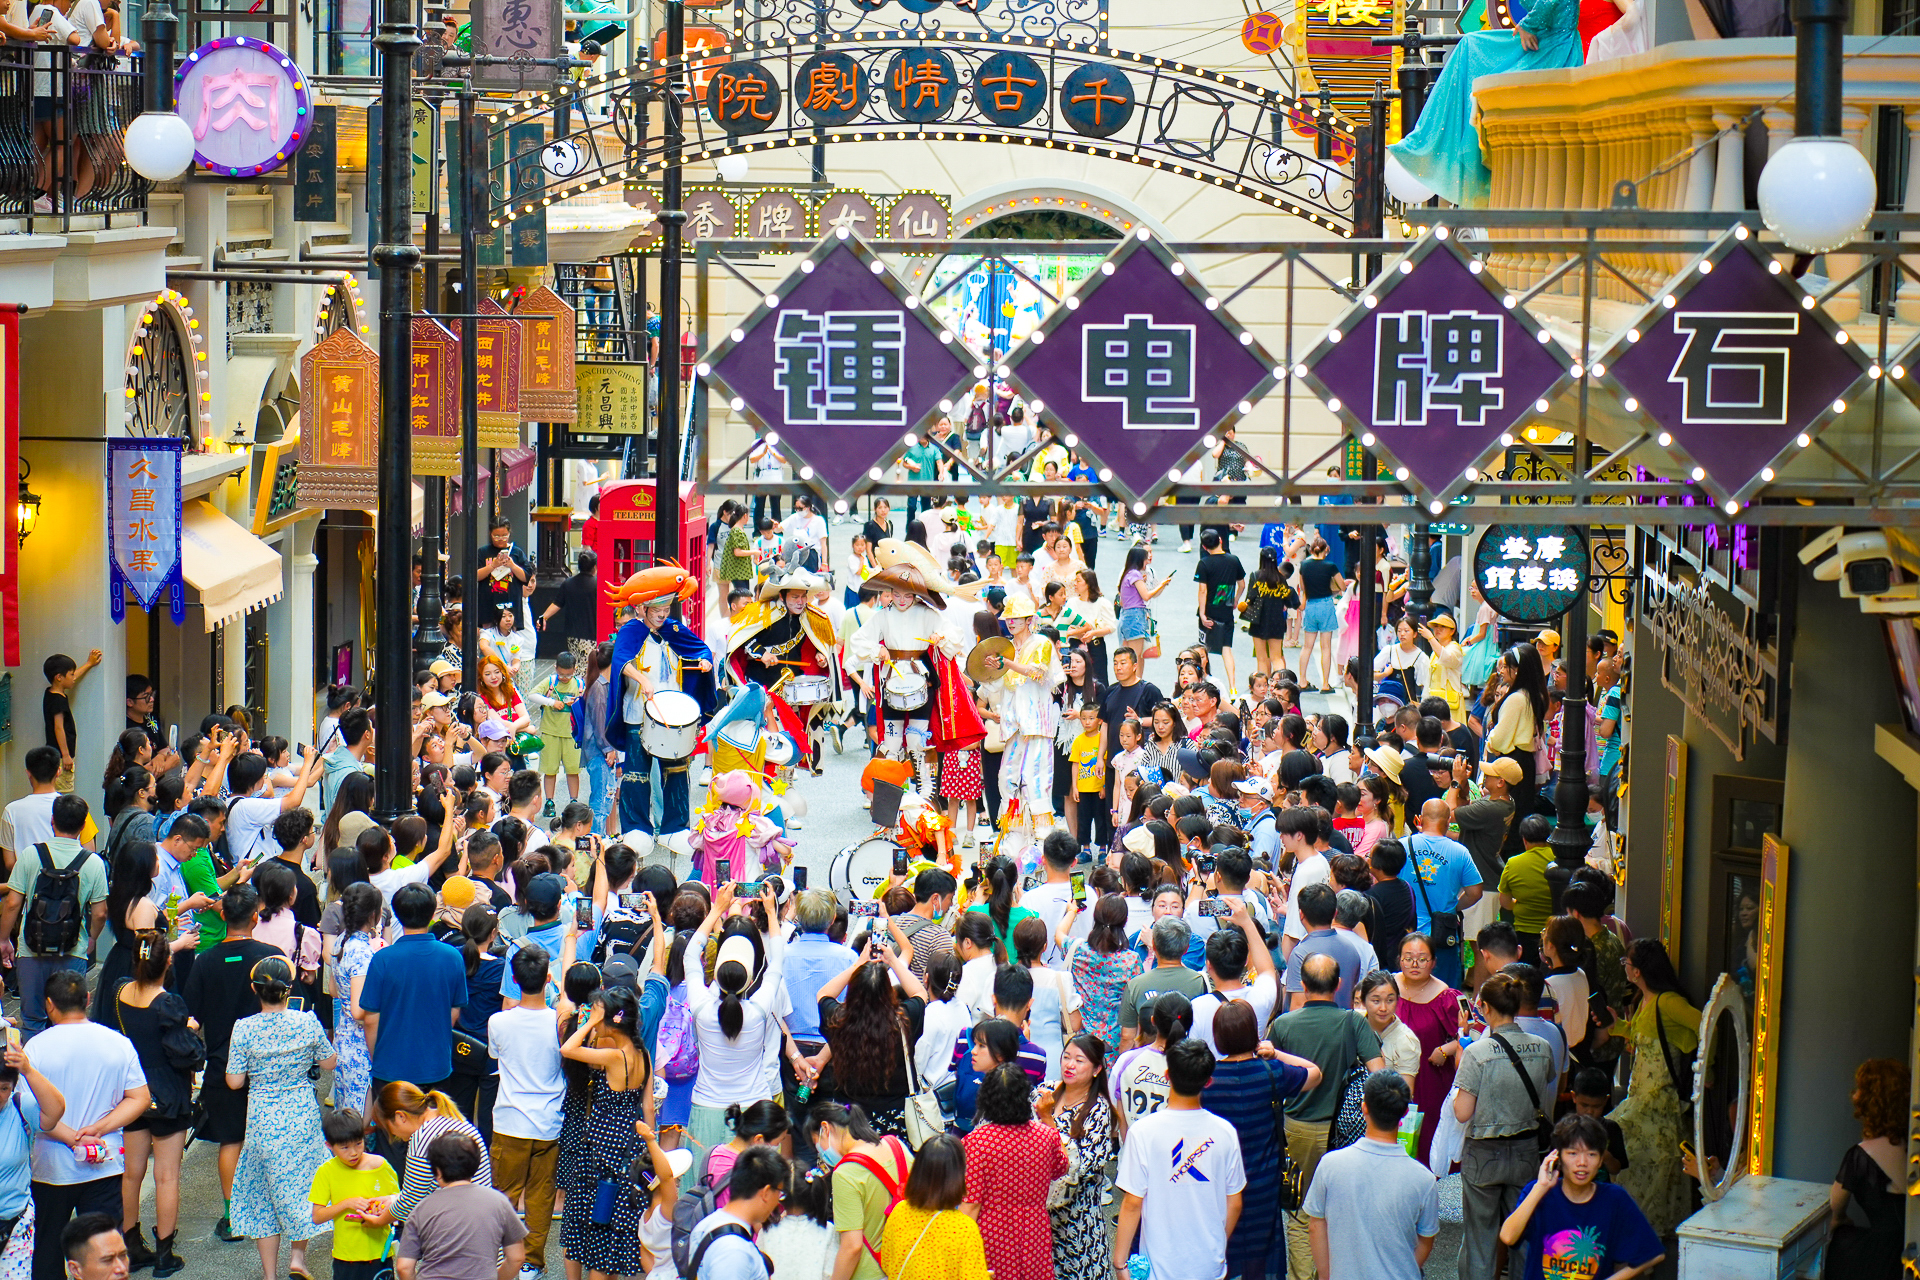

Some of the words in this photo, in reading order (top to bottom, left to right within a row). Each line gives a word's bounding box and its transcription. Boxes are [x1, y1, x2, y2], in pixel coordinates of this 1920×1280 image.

[535, 321, 552, 386] 黄山毛峰
[331, 374, 354, 460] 黄山毛峰
[598, 377, 614, 430] 元昌興
[127, 458, 159, 573] 久昌水果
[1516, 1042, 1541, 1053] SIXTY
[1124, 1086, 1170, 1115] 197
[1168, 1136, 1215, 1184] THOMPSON
